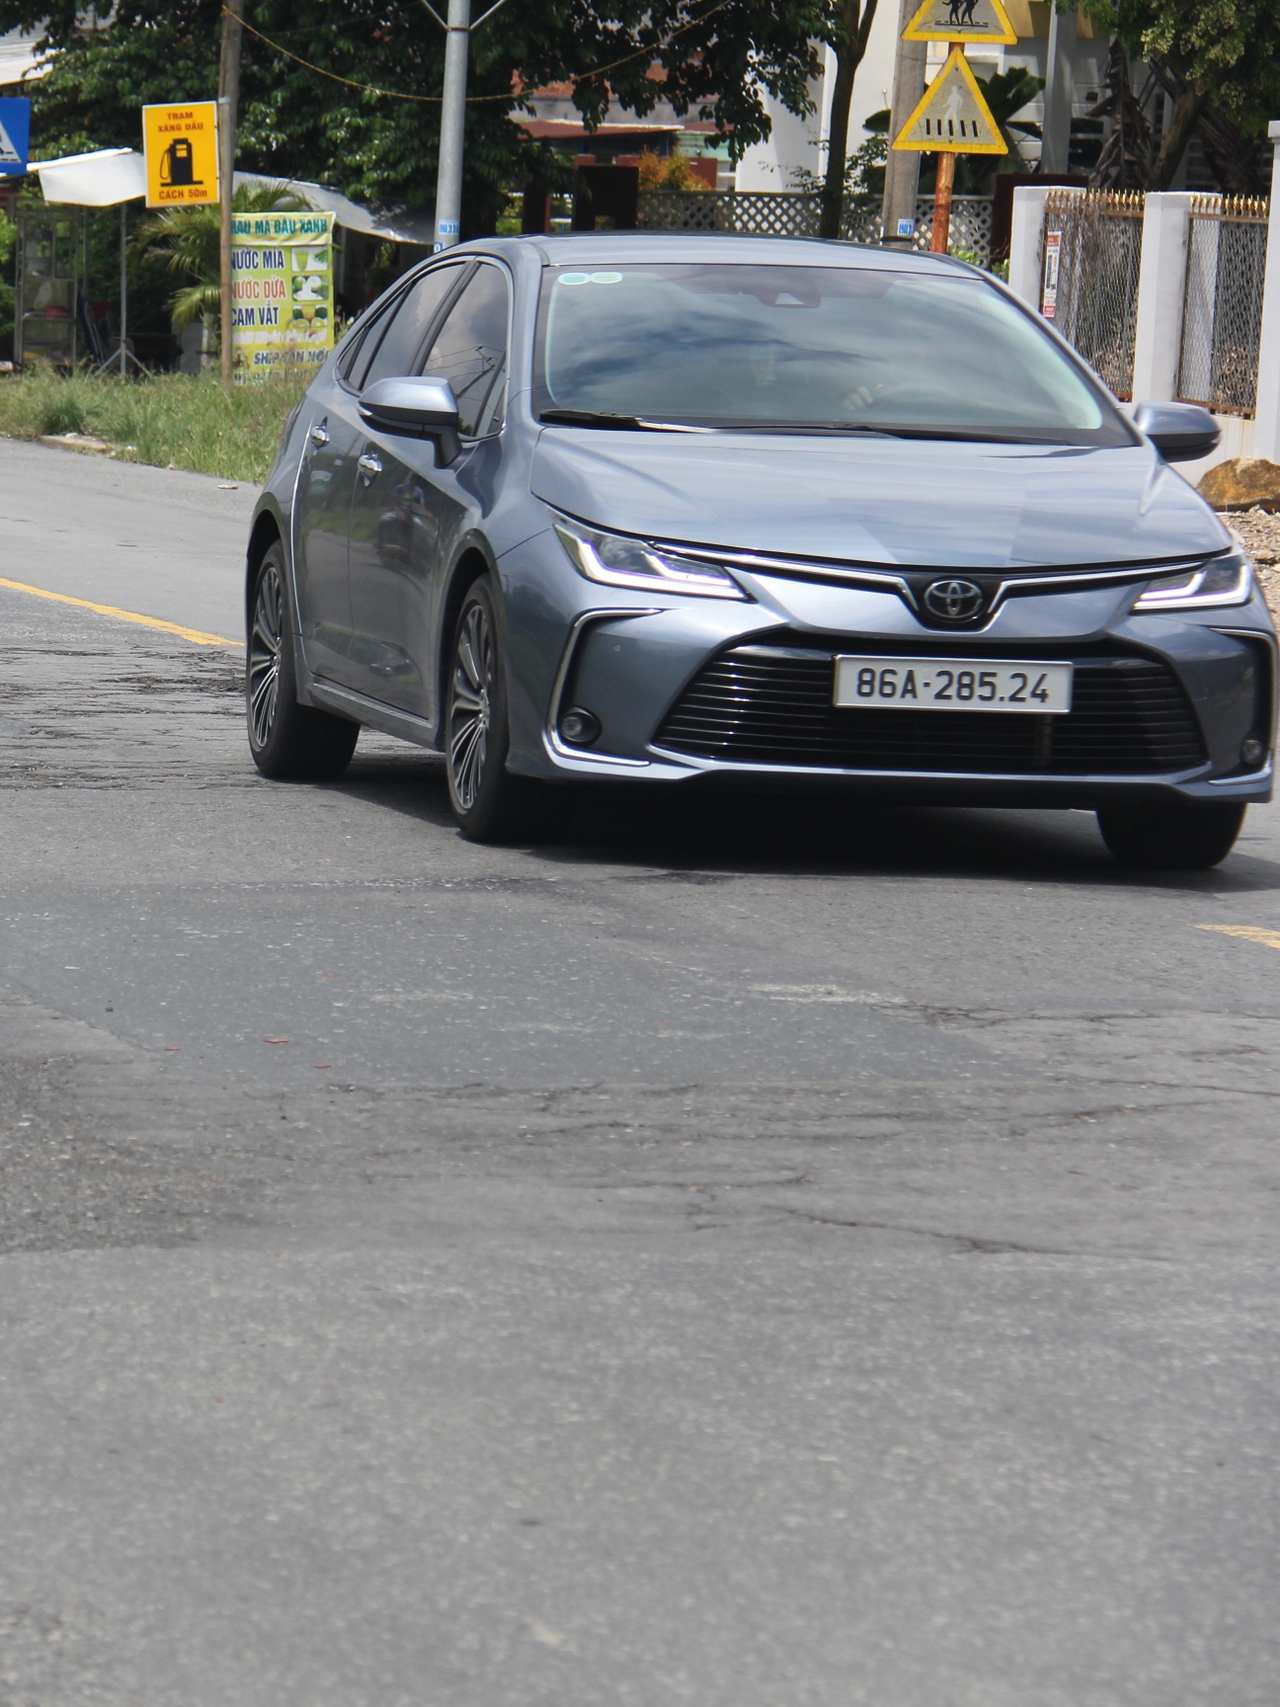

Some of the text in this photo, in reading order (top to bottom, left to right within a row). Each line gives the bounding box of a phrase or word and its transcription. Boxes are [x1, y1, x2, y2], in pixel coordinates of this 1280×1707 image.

[158, 187, 208, 200] CÁCH 50m
[300, 218, 327, 234] XANH
[264, 276, 286, 298] DỪA
[232, 300, 279, 326] CAM VẮT
[857, 667, 1049, 703] 86A-285.24
